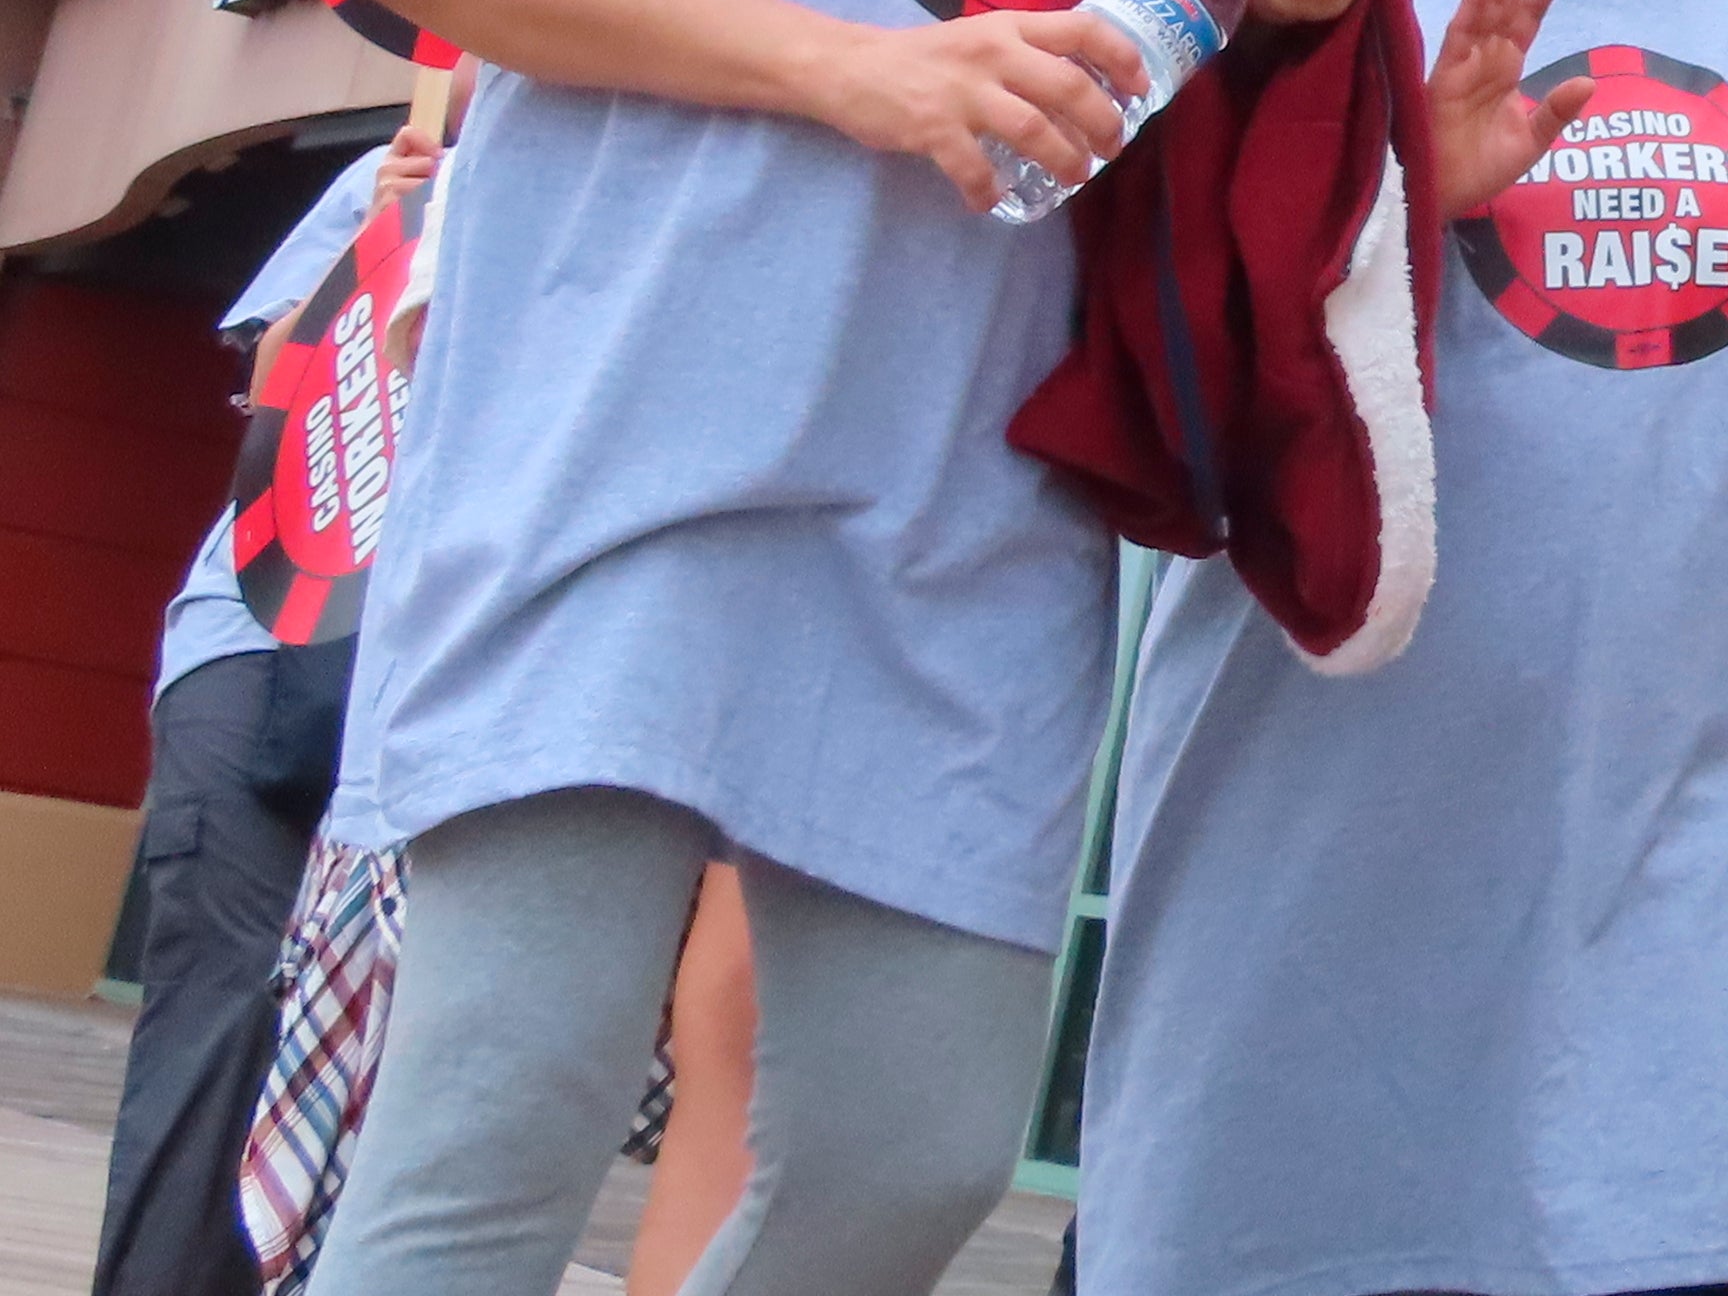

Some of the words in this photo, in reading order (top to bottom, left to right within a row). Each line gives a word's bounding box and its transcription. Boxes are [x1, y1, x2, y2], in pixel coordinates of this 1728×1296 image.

[1561, 110, 1691, 143] CASINO
[1572, 188, 1665, 220] NEED
[1675, 188, 1702, 217] A
[305, 394, 341, 533] CASINO
[334, 293, 390, 566] WORKERS
